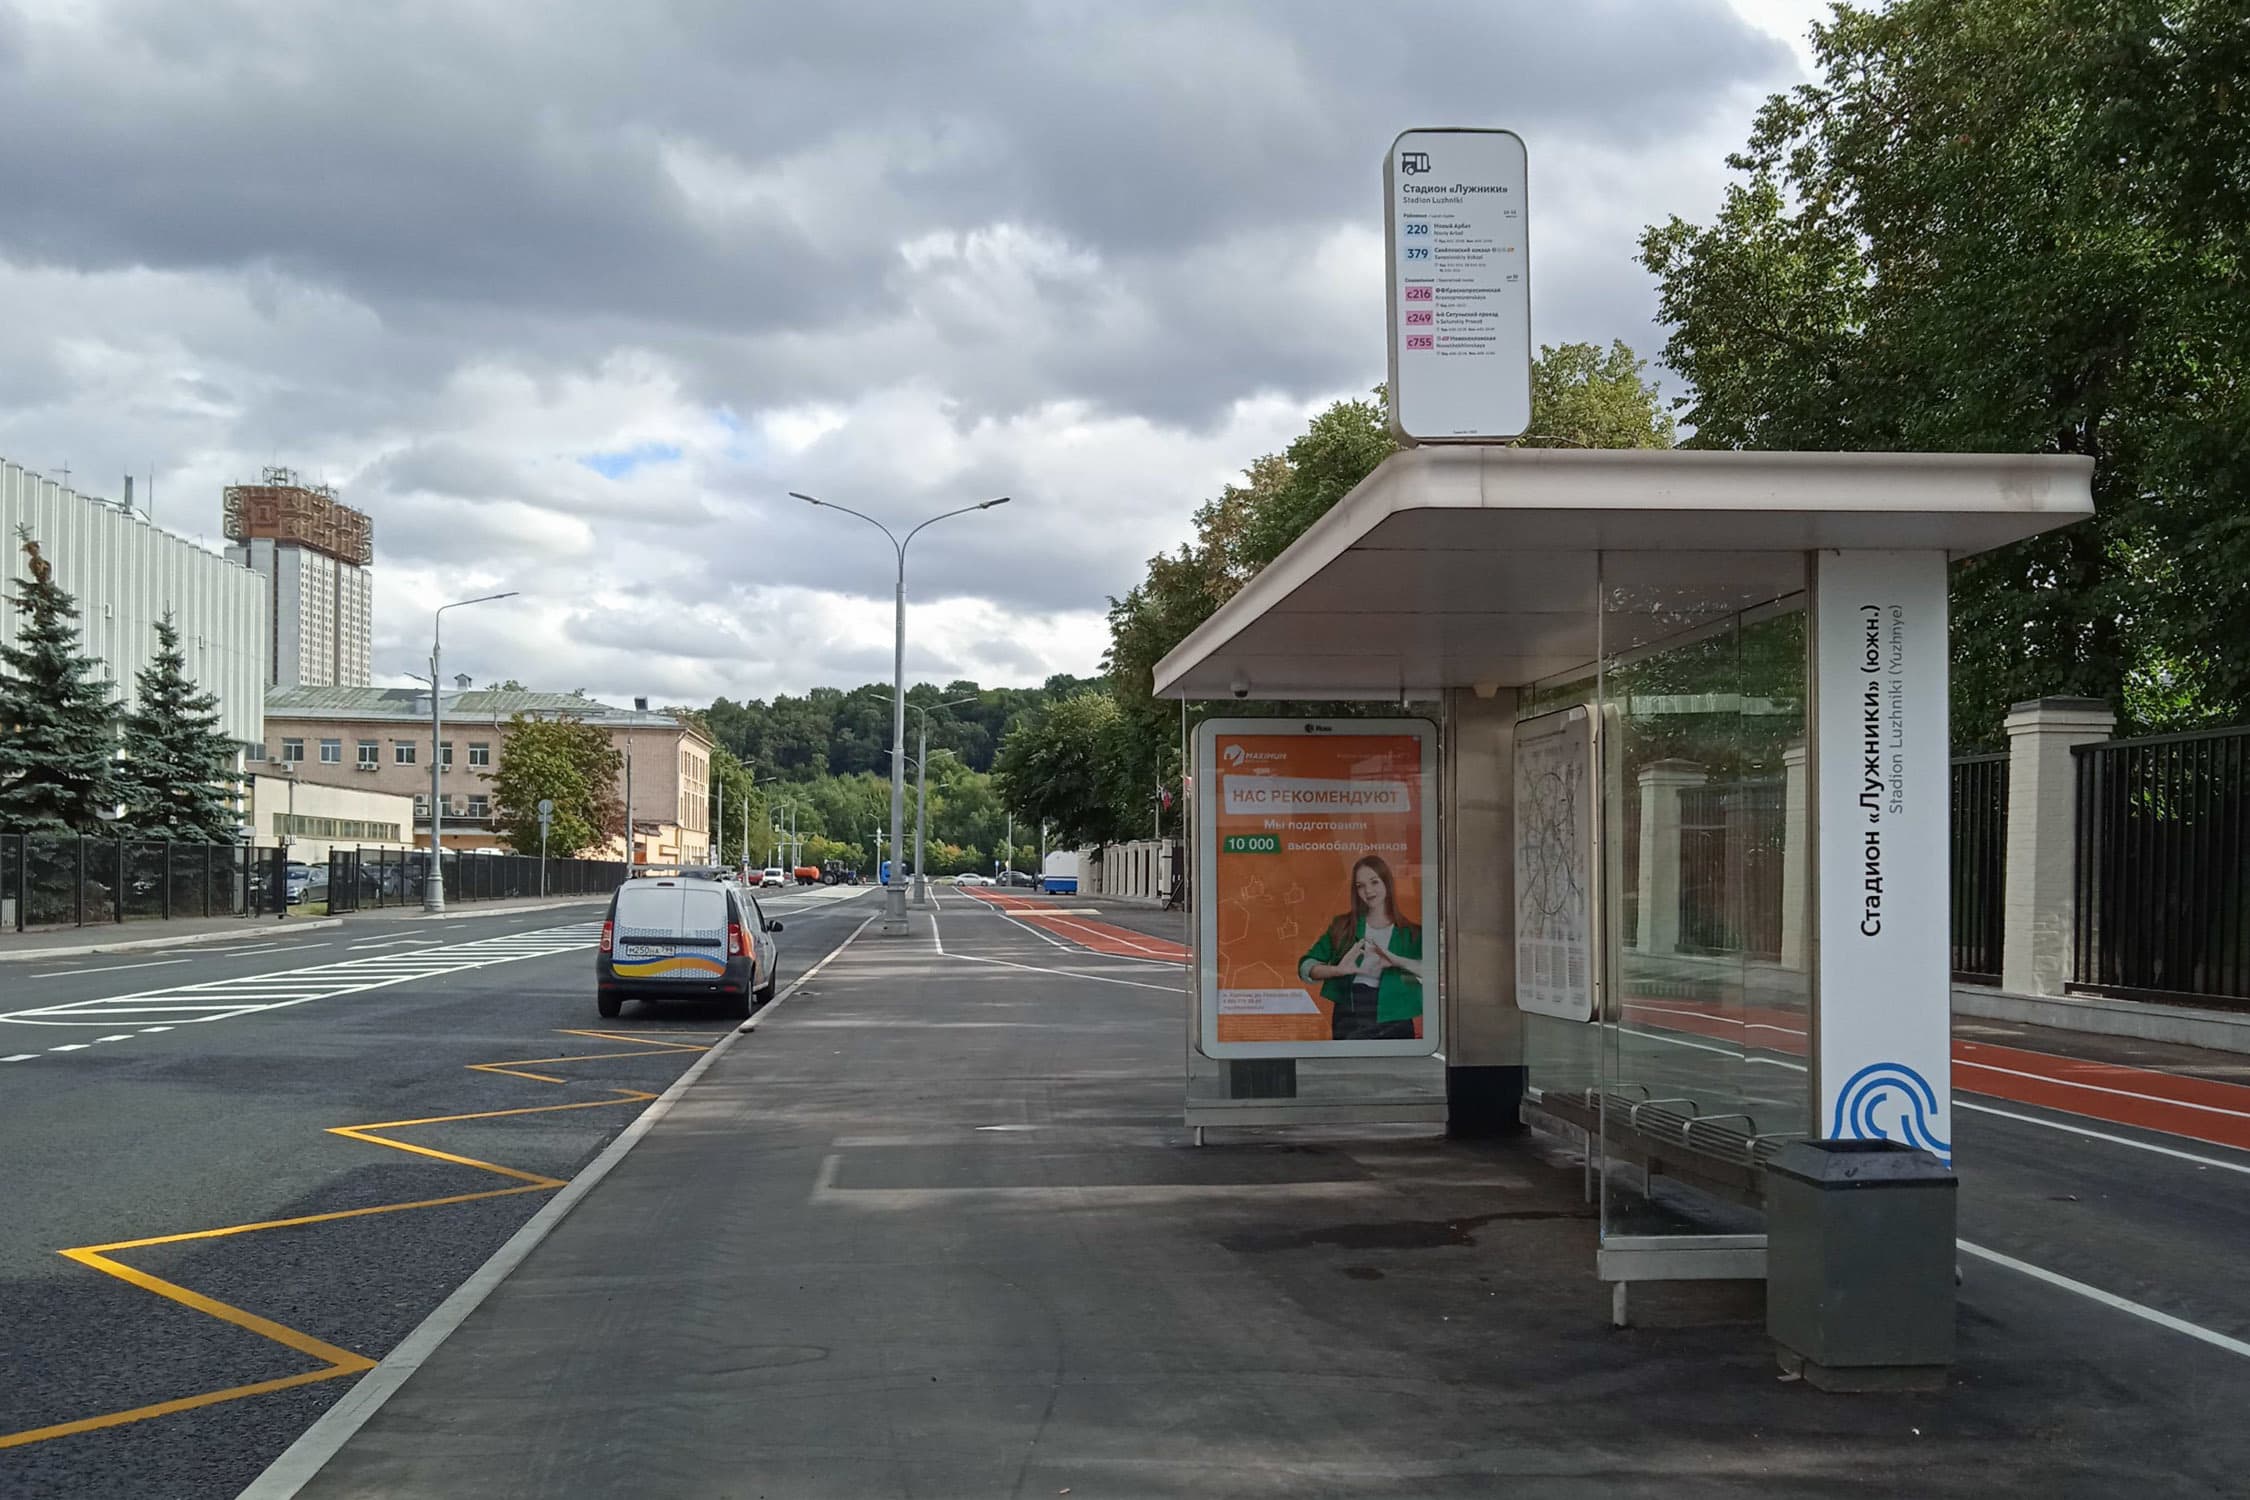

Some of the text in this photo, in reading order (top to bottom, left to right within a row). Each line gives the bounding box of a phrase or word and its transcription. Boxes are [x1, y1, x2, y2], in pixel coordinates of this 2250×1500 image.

[1403, 184, 1508, 195] Стадион «Лужники»
[1407, 224, 1428, 235] 220
[1407, 248, 1428, 259] 379
[1888, 604, 1904, 815] Stadion Luzhniki (Yuzhnye)
[1859, 604, 1884, 937] Стадион «Лужники» (южн.)
[1233, 789, 1398, 806] НАС РЕКОМЕНДУЮТ
[1264, 819, 1368, 832] Мы подготовили
[1229, 838, 1275, 850] 10 000
